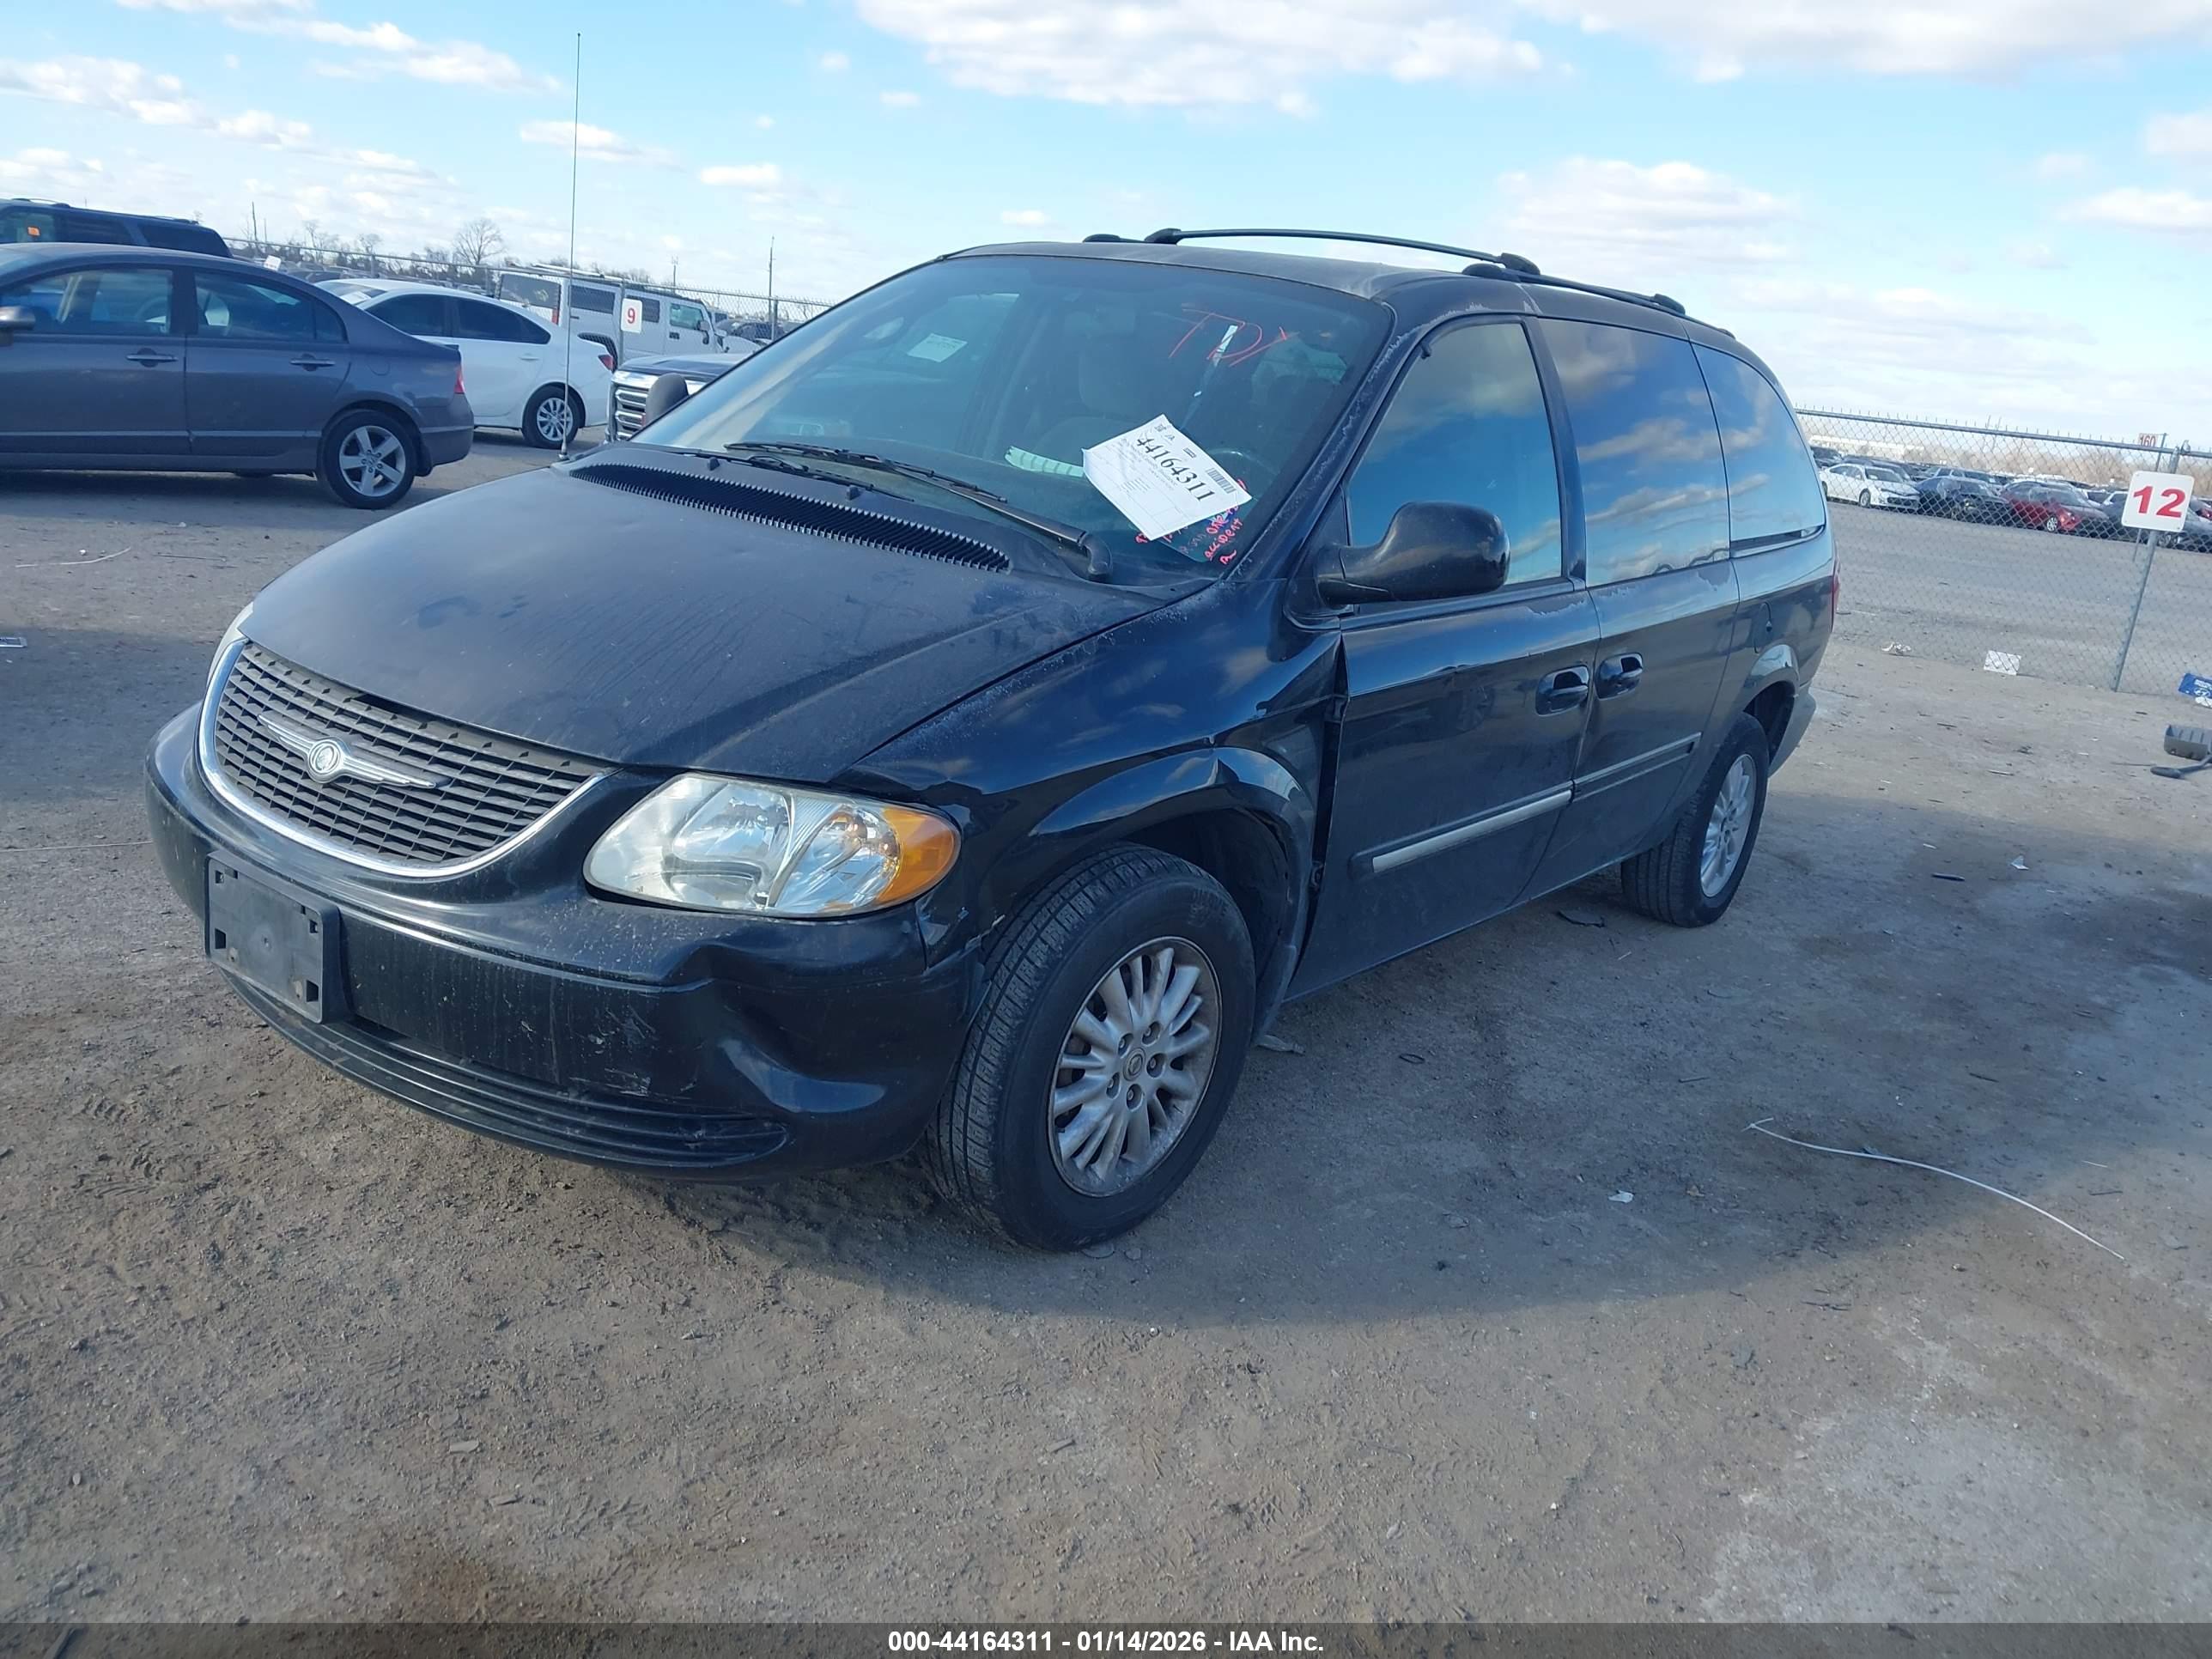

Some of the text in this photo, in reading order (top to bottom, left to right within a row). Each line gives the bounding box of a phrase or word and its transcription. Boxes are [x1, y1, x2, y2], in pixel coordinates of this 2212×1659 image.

[628, 307, 635, 324] 9
[1135, 436, 1216, 502] 44164311
[2133, 485, 2185, 518] 12
